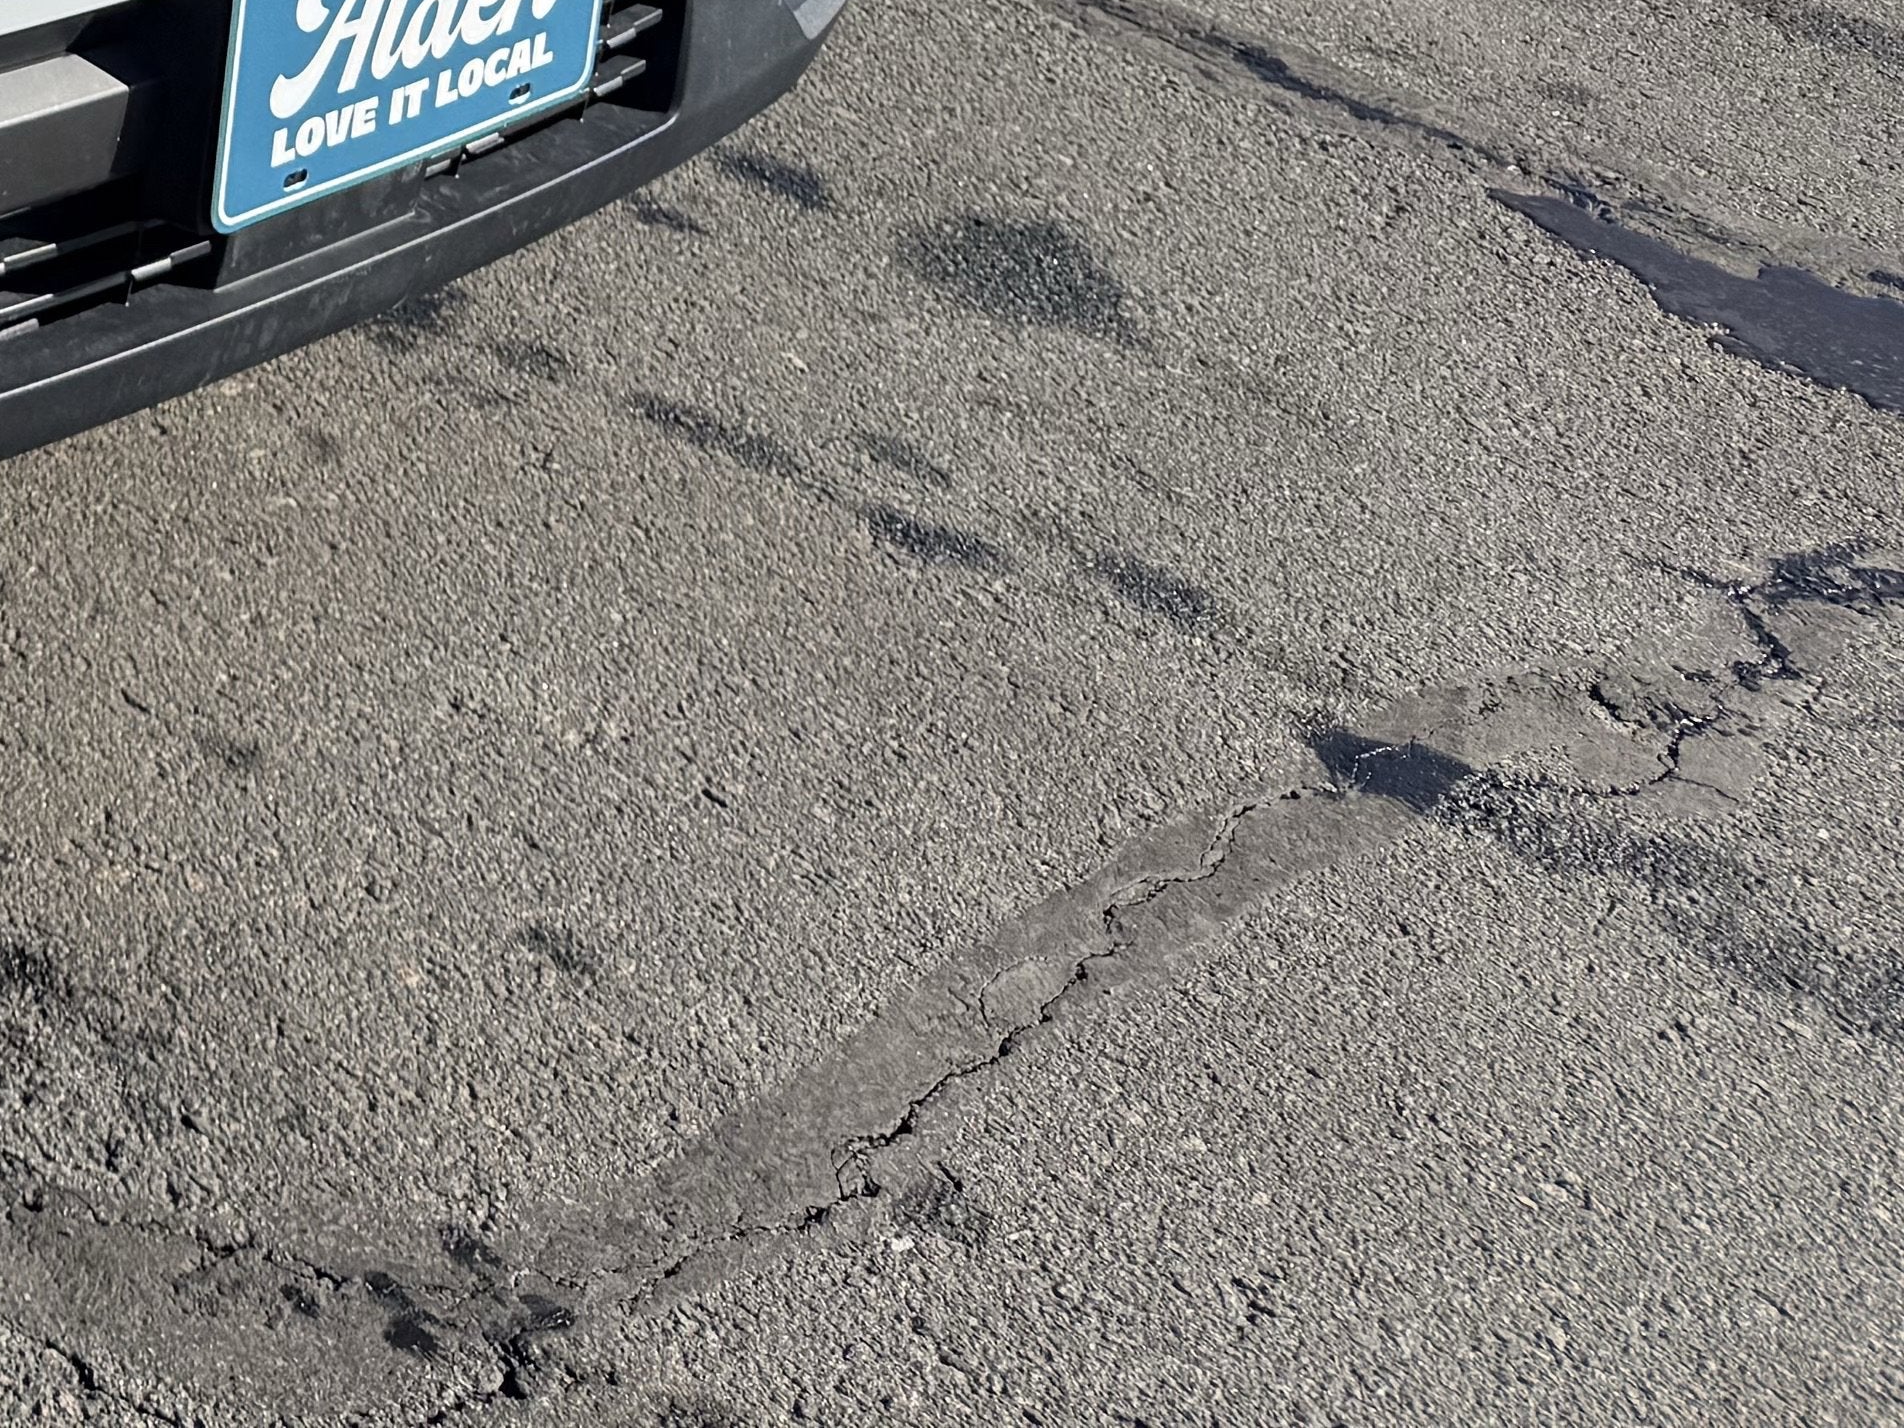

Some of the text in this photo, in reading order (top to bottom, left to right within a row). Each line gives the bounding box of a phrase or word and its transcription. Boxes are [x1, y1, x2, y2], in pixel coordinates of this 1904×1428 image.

[270, 32, 554, 169] LOVE IT LOCAL
